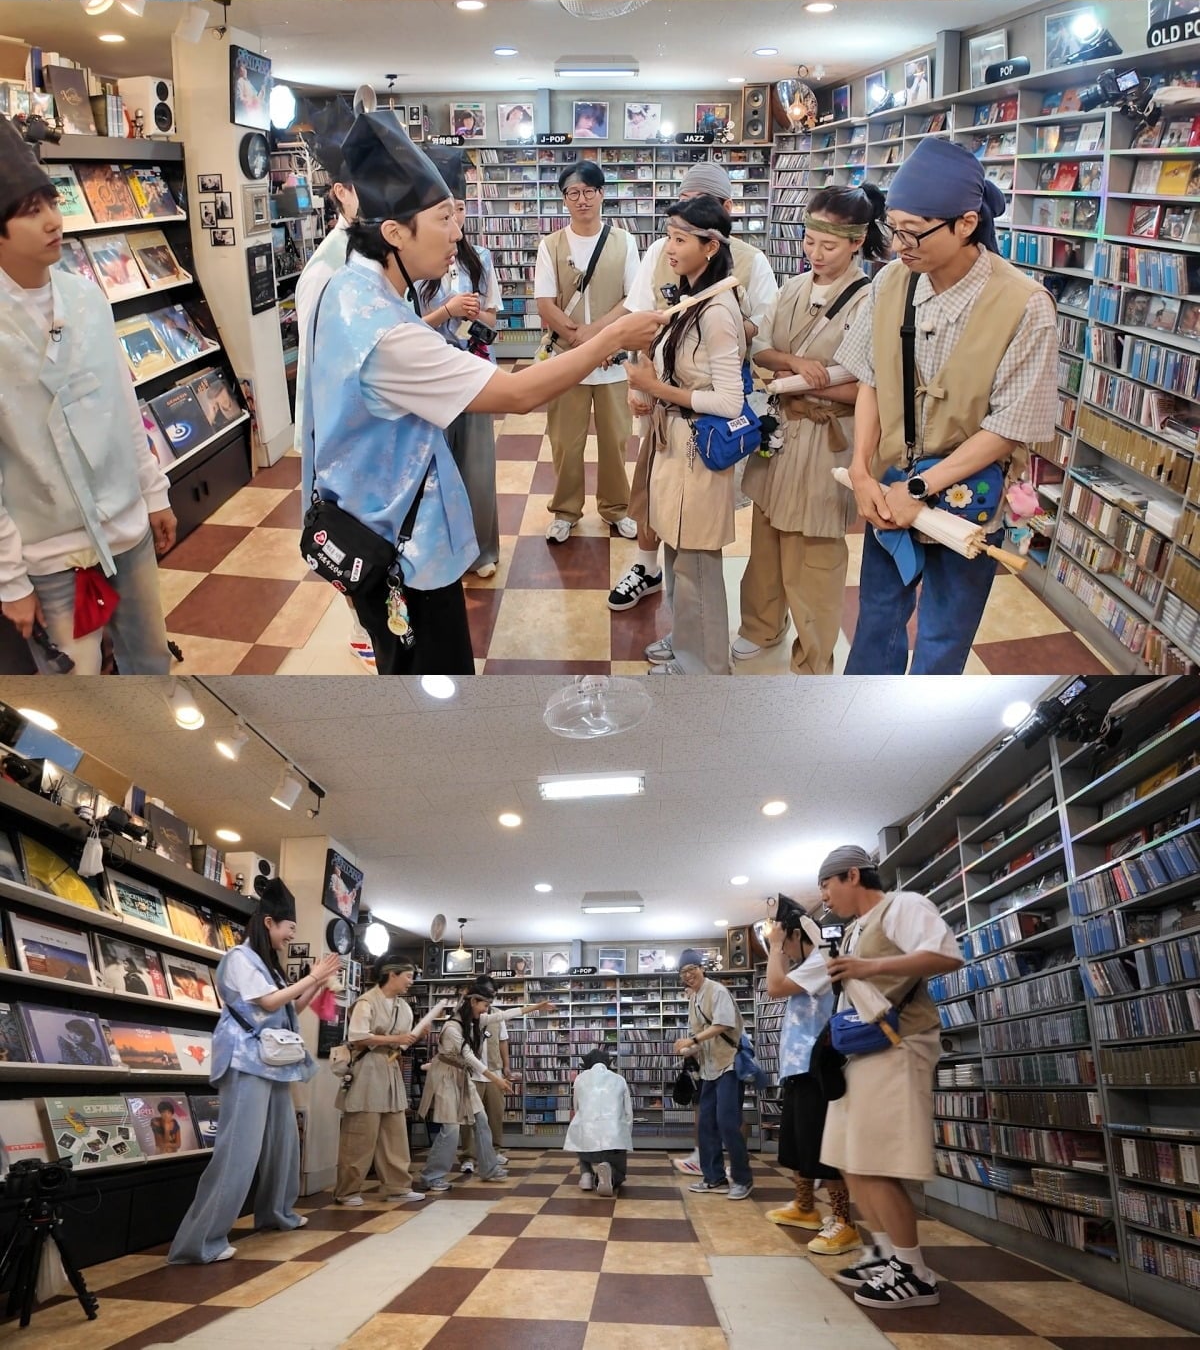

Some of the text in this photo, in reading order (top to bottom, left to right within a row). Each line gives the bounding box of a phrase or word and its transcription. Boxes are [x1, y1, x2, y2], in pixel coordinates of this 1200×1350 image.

[1151, 24, 1181, 47] OLD
[999, 64, 1014, 77] POP
[684, 135, 705, 143] JAZZ
